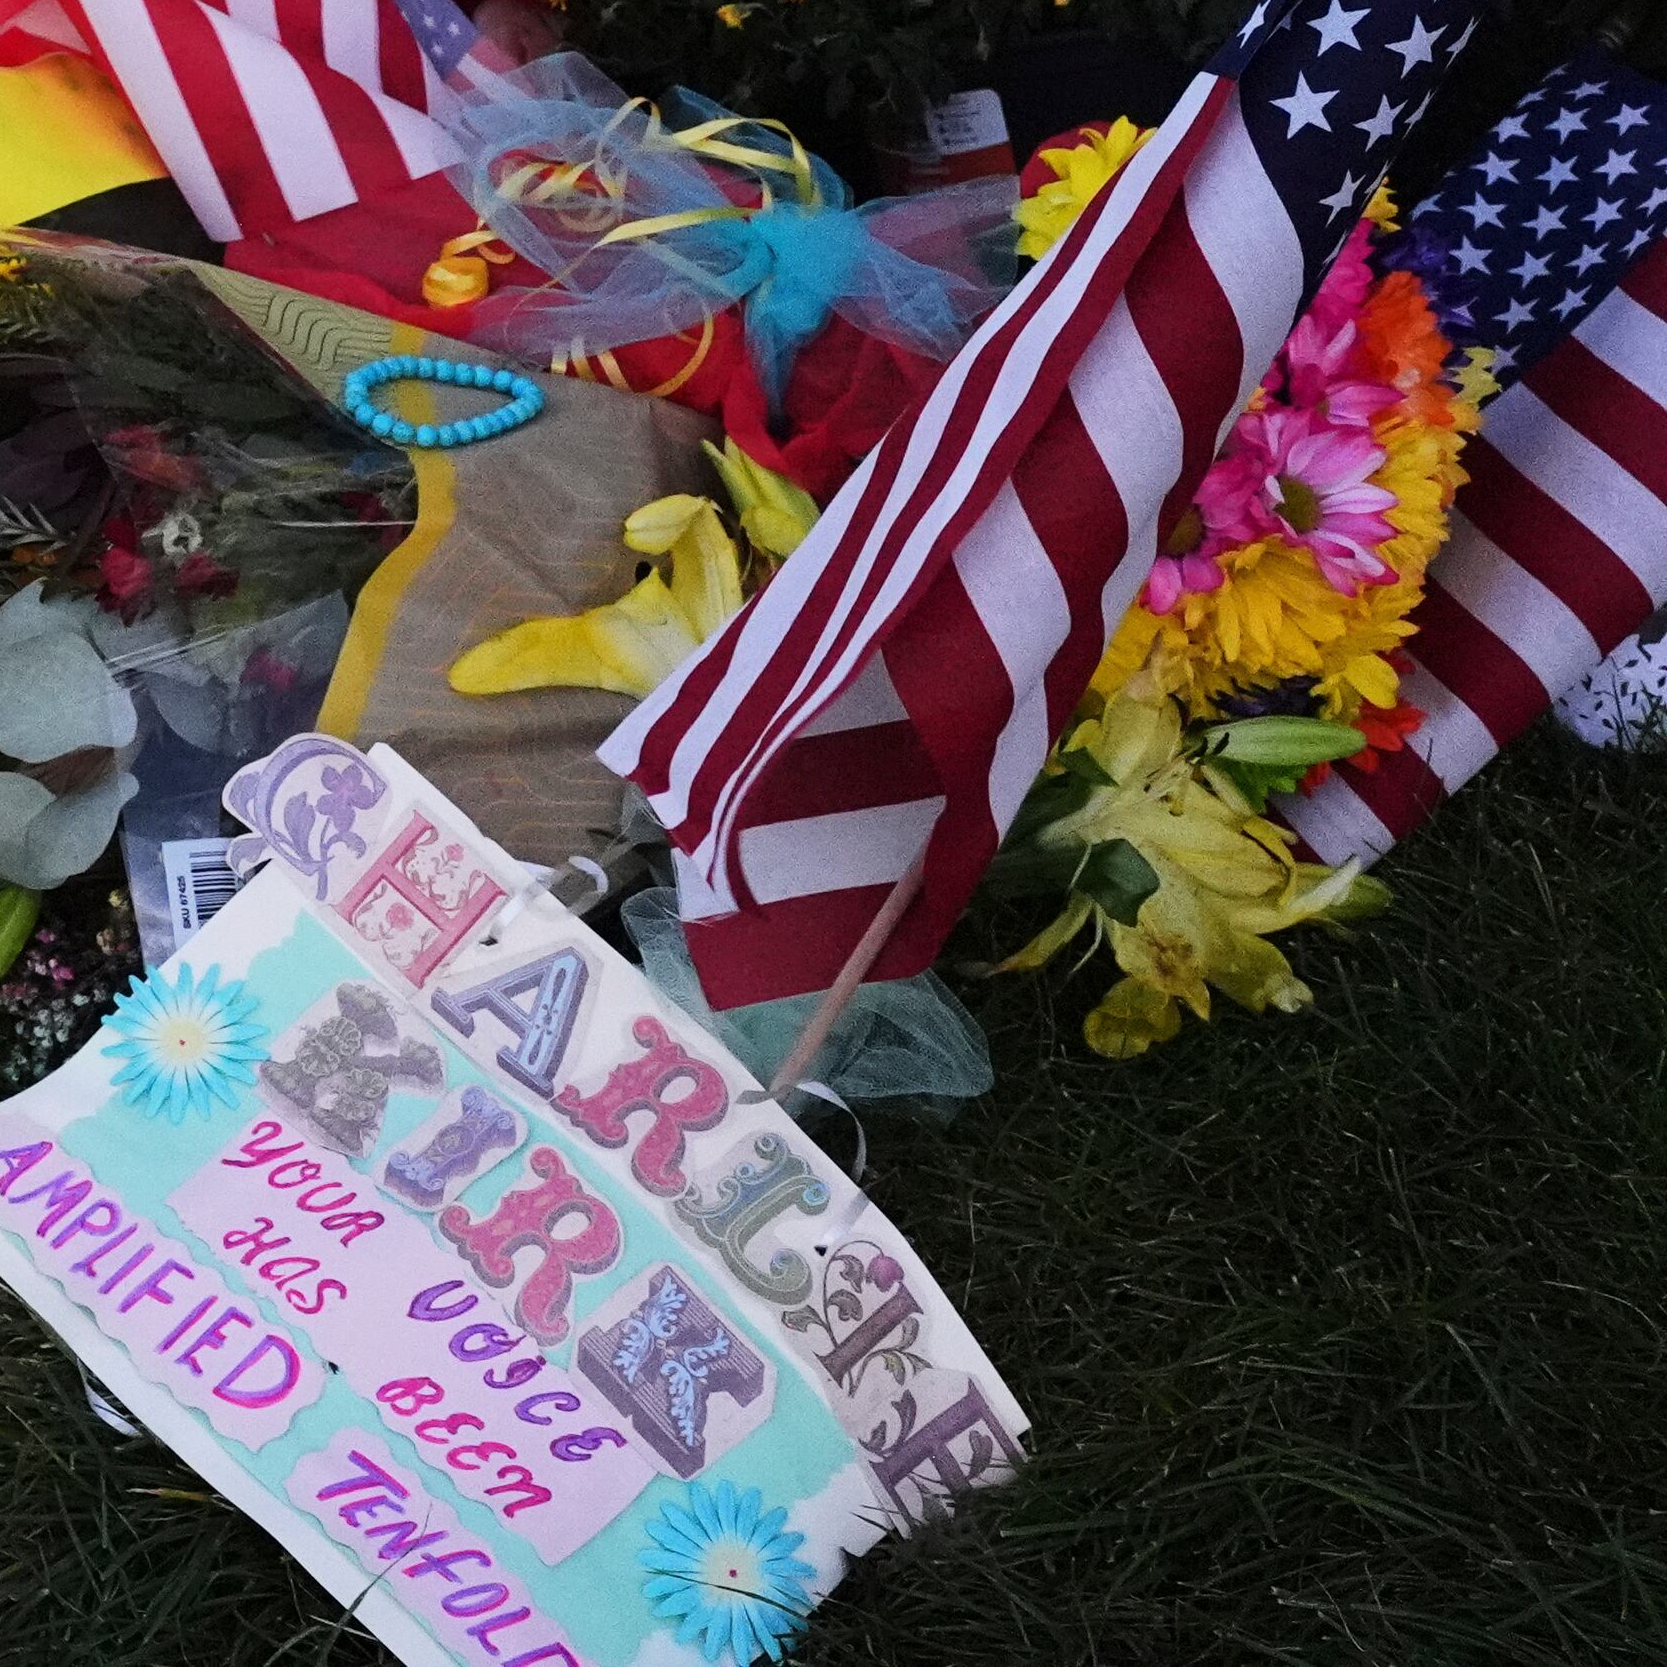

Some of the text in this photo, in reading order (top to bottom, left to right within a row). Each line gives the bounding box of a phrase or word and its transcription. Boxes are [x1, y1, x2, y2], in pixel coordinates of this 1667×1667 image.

[182, 908, 192, 929] SKU
[219, 1119, 627, 1462] YOUR VOICE
[227, 735, 1027, 1528] CHARLIE
[261, 981, 769, 1479] KIRK
[222, 1215, 553, 1519] HAS BEEN
